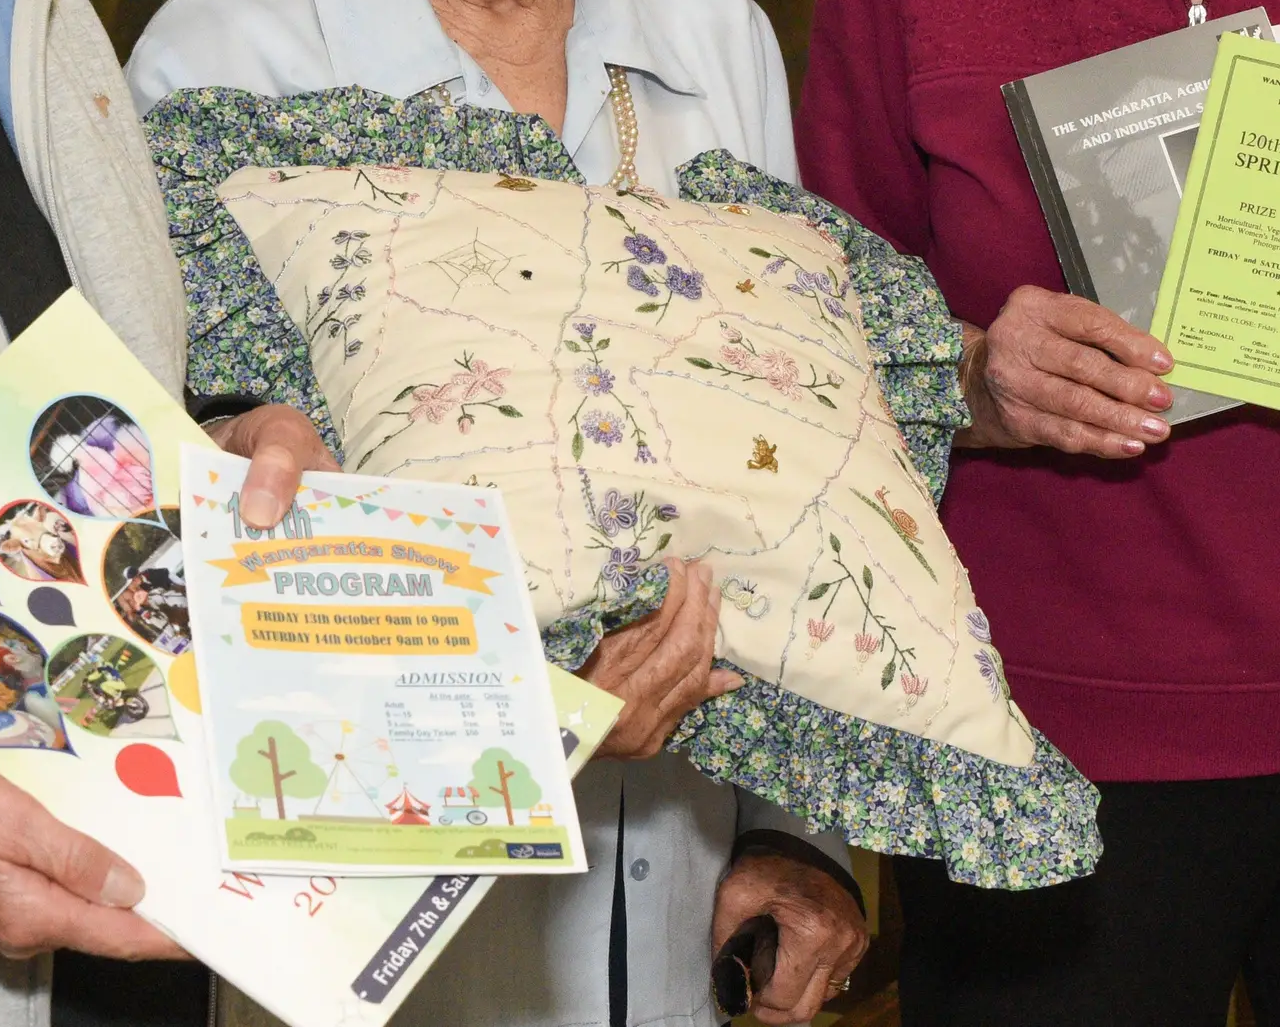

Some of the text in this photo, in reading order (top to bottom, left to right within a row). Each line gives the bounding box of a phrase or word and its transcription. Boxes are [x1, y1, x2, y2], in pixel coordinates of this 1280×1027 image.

[1052, 122, 1077, 136] THE
[1080, 92, 1172, 127] WANGARATTA
[1083, 132, 1111, 149] AND
[1115, 107, 1193, 139] INDUSTRIAL
[1240, 202, 1276, 219] PRIZE
[1238, 228, 1268, 240] Women's
[1208, 248, 1240, 260] FRIDAY
[1199, 310, 1229, 322] ENTRIES
[239, 541, 460, 574] Wangaratta Show
[274, 571, 433, 596] PROGRAM
[257, 610, 459, 627] FRIDAY 13th October 9am to 9pm
[252, 630, 470, 647] SATURDAY 14th October 9am to 4pm
[395, 672, 502, 684] ADMISSION
[372, 935, 418, 986] Friday
[409, 908, 439, 940] 7th
[431, 894, 450, 912] &
